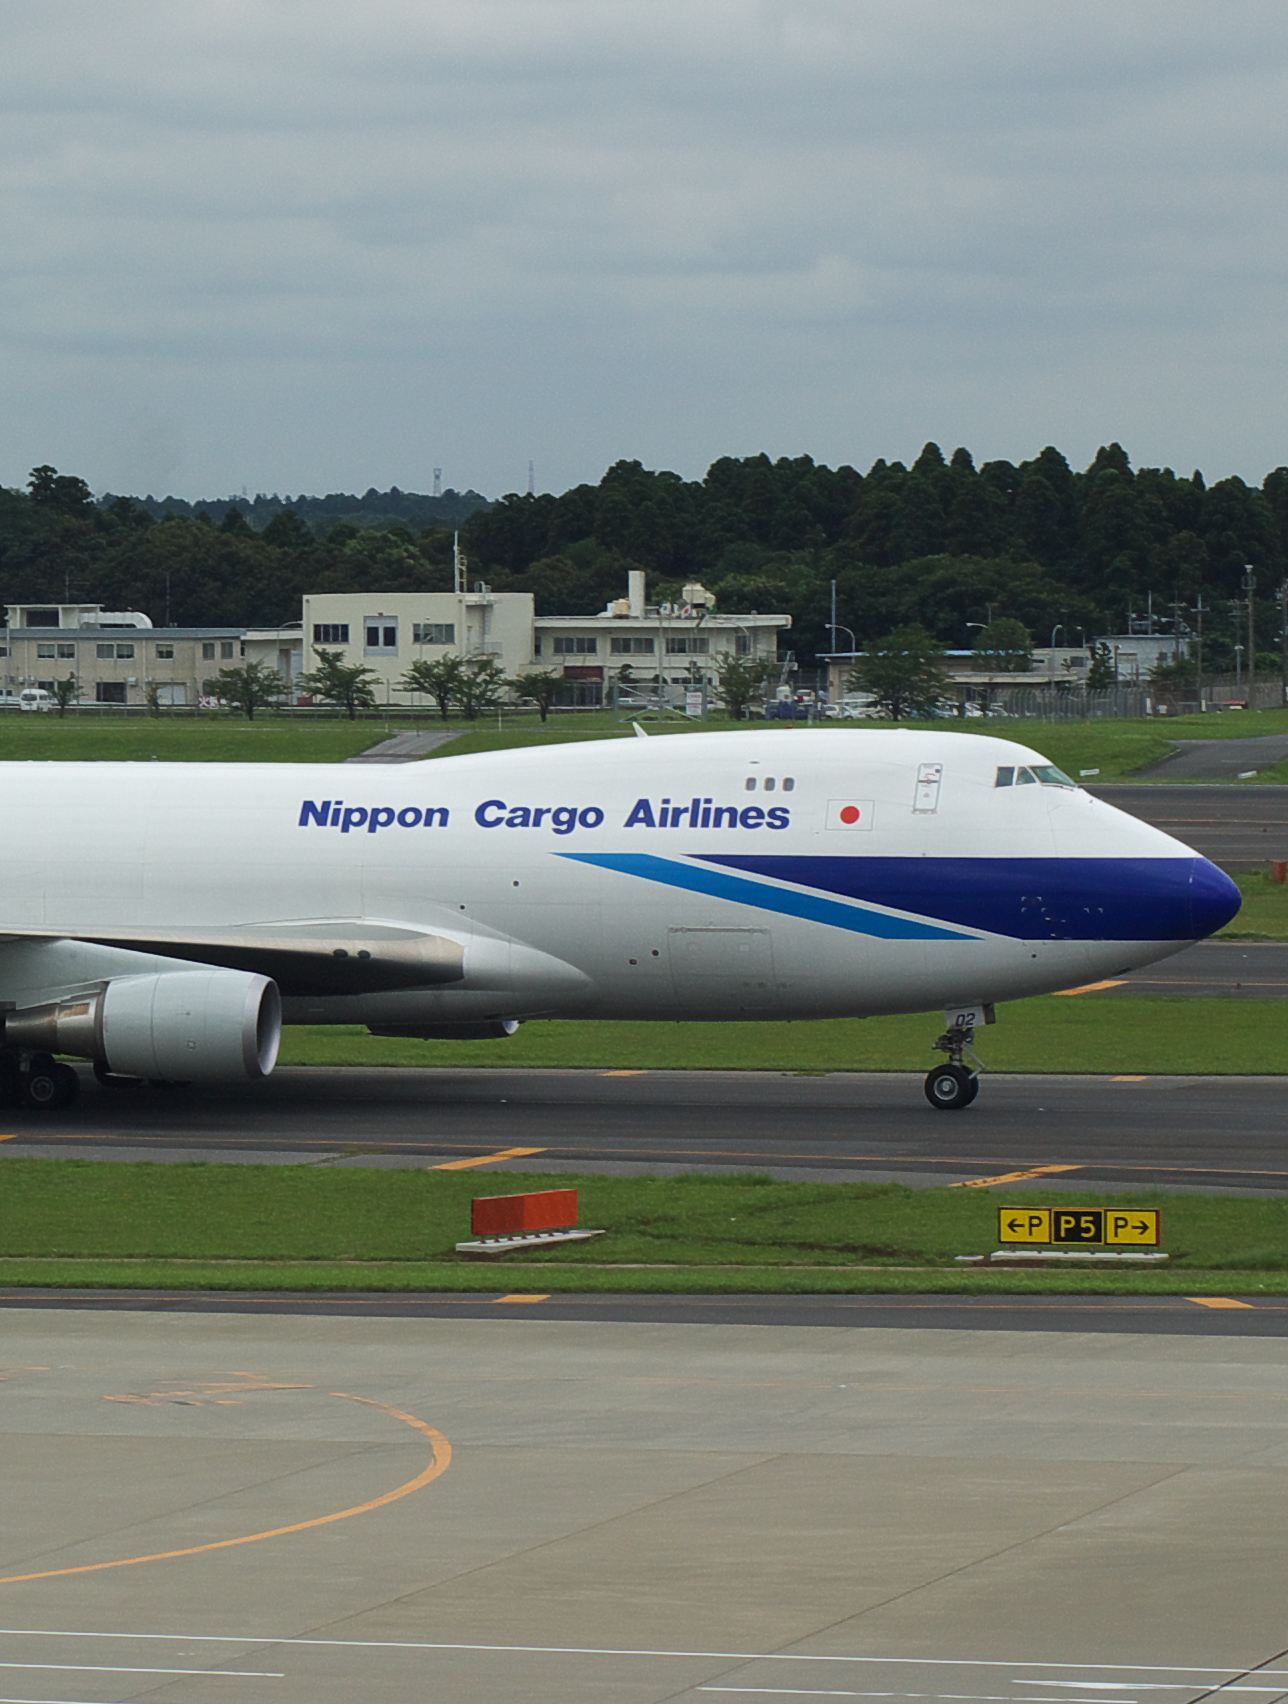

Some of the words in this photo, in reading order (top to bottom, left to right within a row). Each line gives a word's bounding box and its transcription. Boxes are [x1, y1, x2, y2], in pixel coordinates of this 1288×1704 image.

[298, 800, 450, 834] Nippon
[474, 799, 605, 835] Cargo
[623, 798, 791, 829] Airlines
[955, 1012, 976, 1027] 02
[1028, 1215, 1043, 1236] P
[1060, 1216, 1096, 1238] P5
[1113, 1216, 1128, 1238] P
